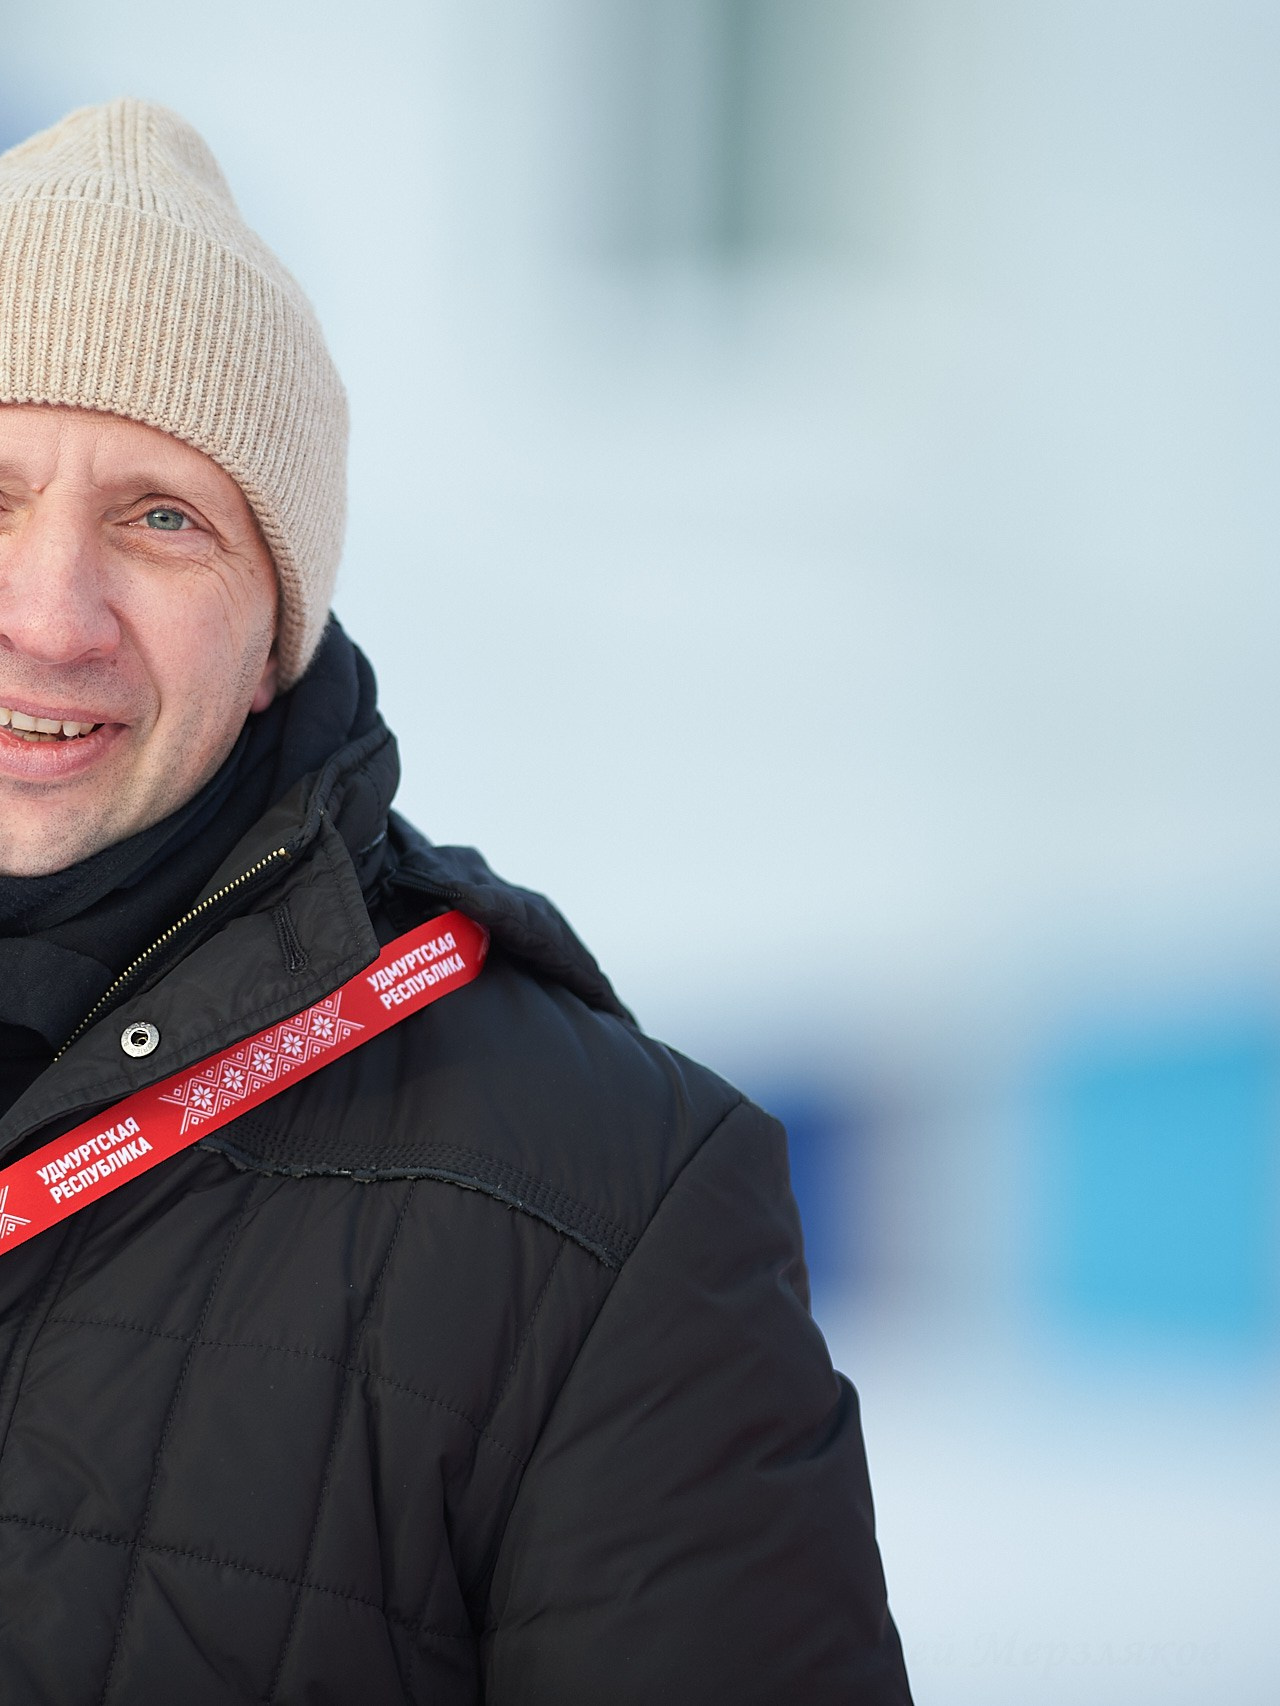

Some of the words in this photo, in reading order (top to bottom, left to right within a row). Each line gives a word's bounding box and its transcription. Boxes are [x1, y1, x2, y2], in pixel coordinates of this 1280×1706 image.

[367, 932, 457, 992] УДМУРТСКАЯ
[379, 953, 466, 1010] РЕСПУБЛИКА
[36, 1116, 141, 1185] УДМУРТСКАЯ
[49, 1136, 154, 1204] РЕСПУБЛИКА
